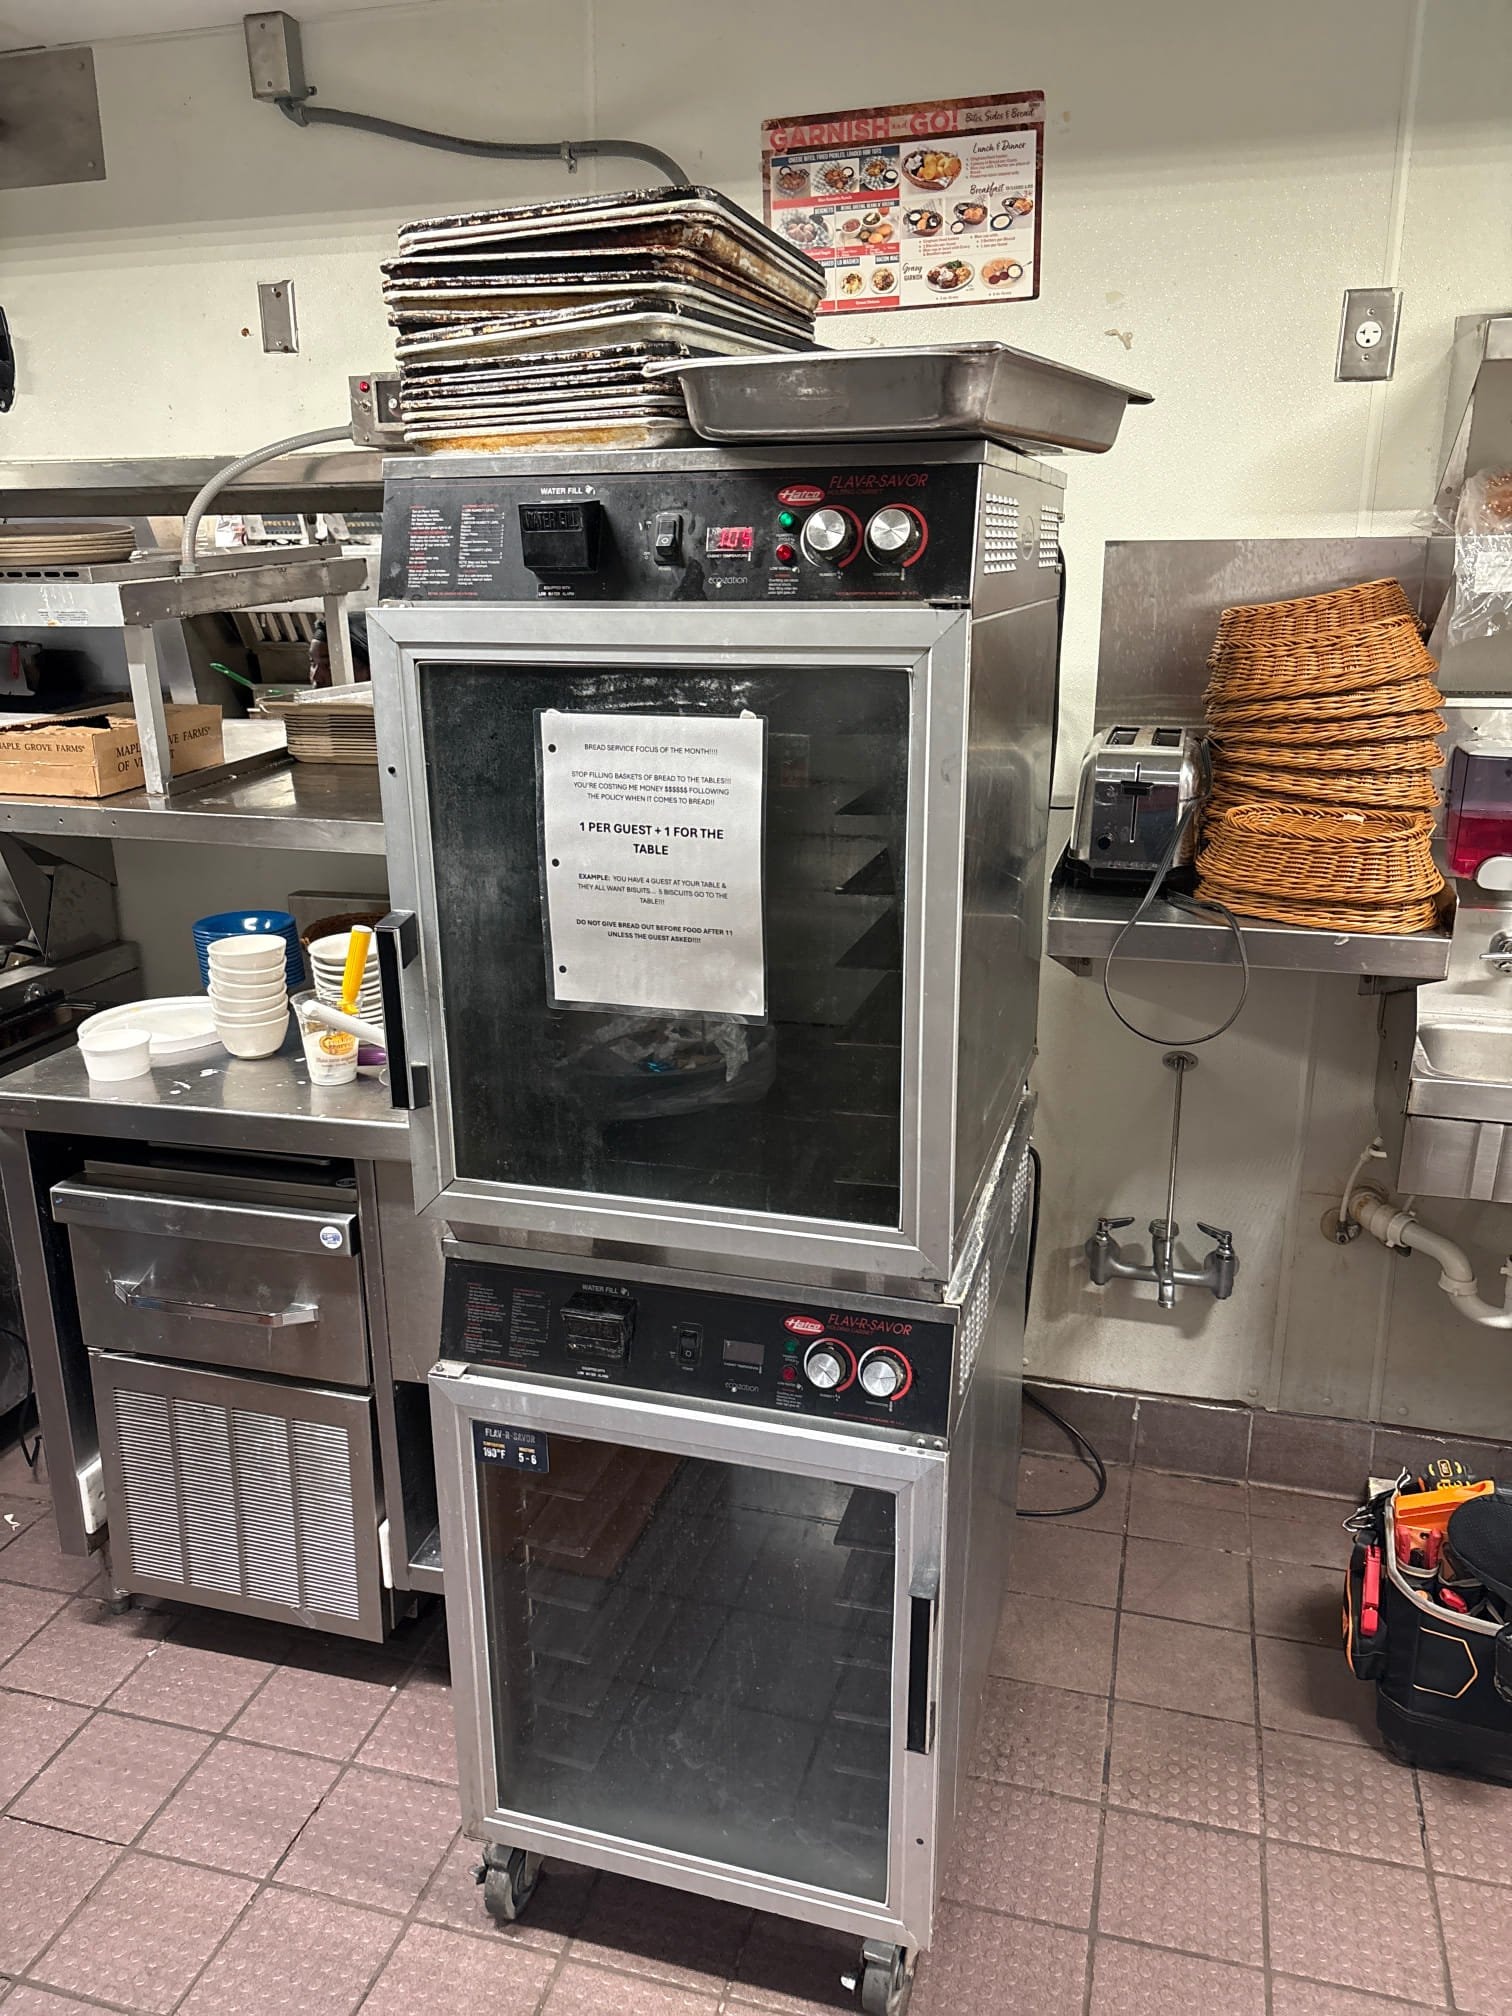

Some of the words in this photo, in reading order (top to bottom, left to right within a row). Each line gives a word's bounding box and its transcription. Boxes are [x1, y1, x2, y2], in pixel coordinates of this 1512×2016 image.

[770, 117, 890, 152] GARNISH
[910, 108, 959, 135] GO!
[973, 143, 995, 153] Lunch
[1002, 140, 1026, 151] Dinner
[970, 181, 1004, 197] Breakfast
[902, 263, 922, 274] Gravy
[829, 474, 928, 489] FLAV-R-SAVOR
[541, 487, 566, 495] WATER
[568, 487, 582, 495] FILL
[779, 489, 821, 501] Hatco
[24, 743, 52, 752] GROVE
[116, 743, 141, 759] MAPL
[118, 759, 130, 773] OF
[689, 787, 729, 795] FOLLOWING
[579, 822, 585, 832] 1
[588, 823, 611, 833] PER
[614, 824, 651, 835] GUEST
[664, 827, 670, 836] 1
[673, 827, 698, 838] FOR
[700, 828, 724, 840] THE
[633, 843, 669, 855] TABLE
[664, 889, 693, 897] BISCUITS
[582, 1284, 603, 1293] WATER
[605, 1286, 618, 1294] FILL
[785, 1317, 822, 1333] Hatco
[828, 1313, 913, 1336] FLAV-R-SAVOR
[485, 1428, 536, 1443] FLAV-R-SAVOR
